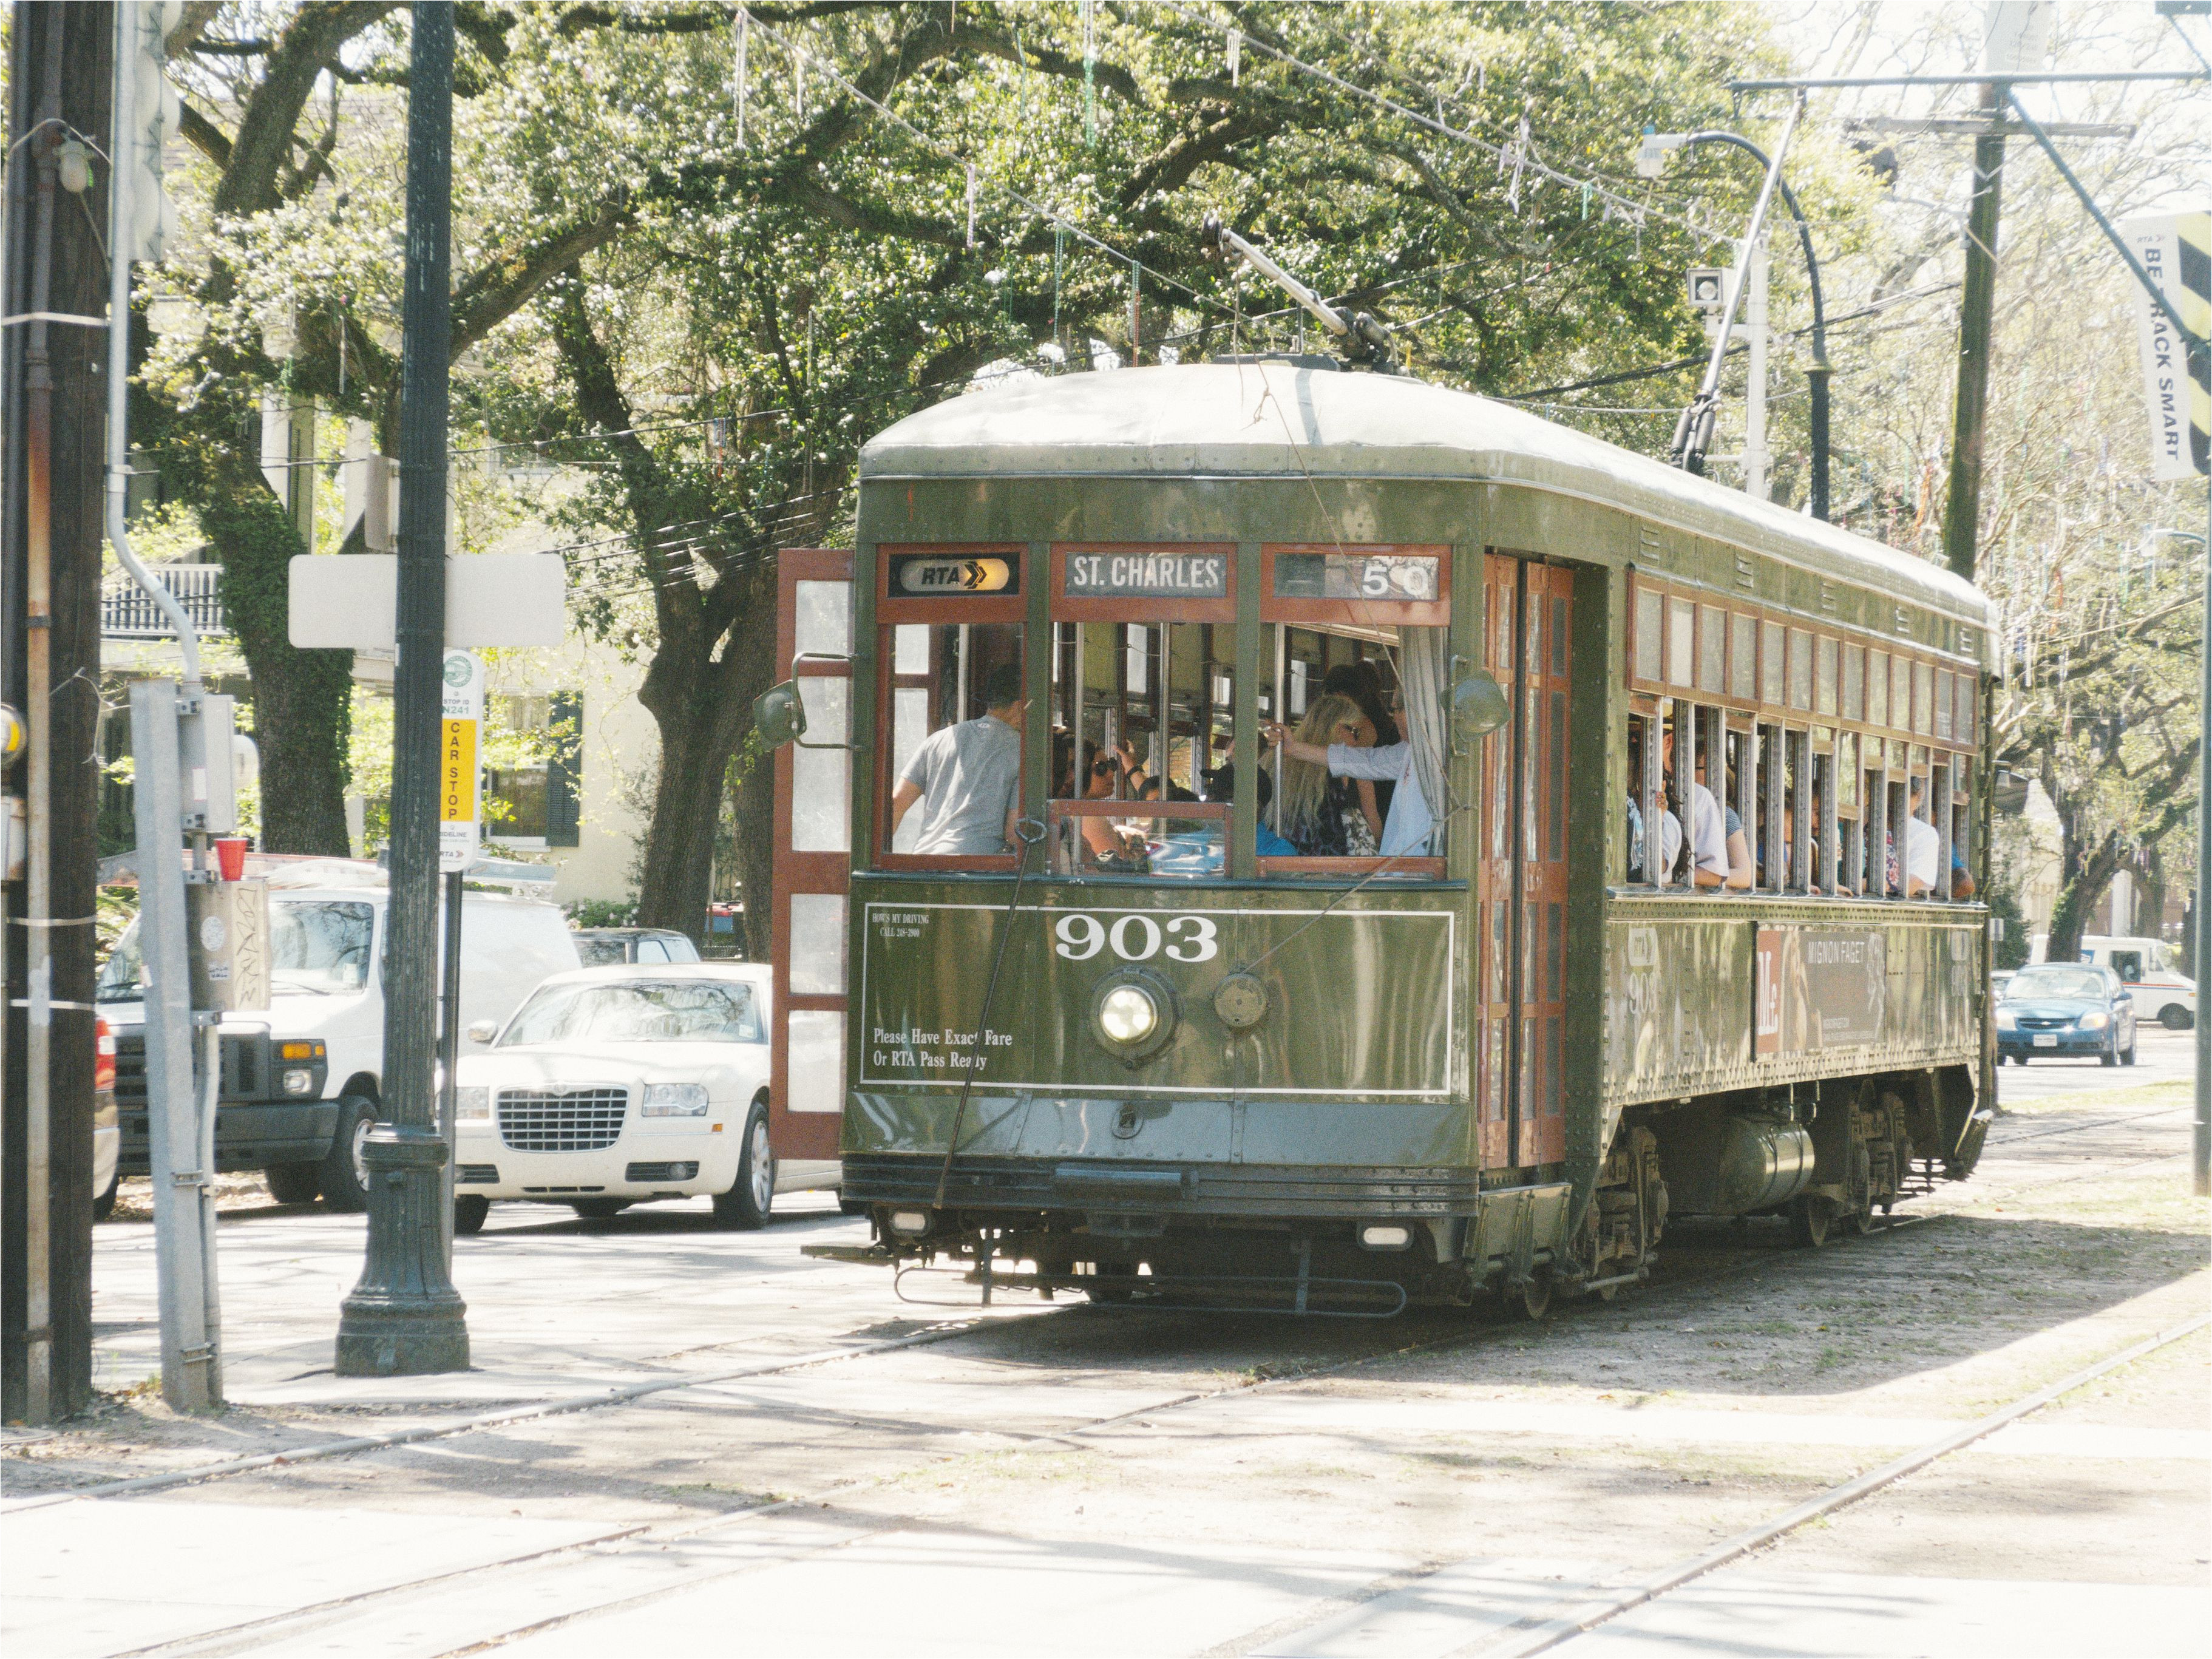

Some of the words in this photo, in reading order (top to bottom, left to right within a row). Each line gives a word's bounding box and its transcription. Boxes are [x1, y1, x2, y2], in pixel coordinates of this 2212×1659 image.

[2145, 248, 2163, 278] BE
[2159, 377, 2178, 461] SMART
[921, 566, 960, 585] RTA
[1074, 555, 1105, 586] ST.
[1111, 557, 1219, 588] CHARLES
[450, 722, 460, 761] CAR
[449, 767, 459, 819] STOP
[892, 914, 901, 923] MY
[903, 914, 929, 924] DRIVING
[880, 927, 895, 937] CALL
[1055, 914, 1218, 963] 903
[1807, 941, 1839, 964] MIGNON
[1841, 941, 1865, 964] FAGET
[874, 1028, 907, 1044] Please
[911, 1028, 940, 1045] Have
[985, 1030, 1013, 1046] Fare
[873, 1050, 887, 1067] Or
[891, 1050, 917, 1067] RTA
[920, 1051, 945, 1068] Pass
